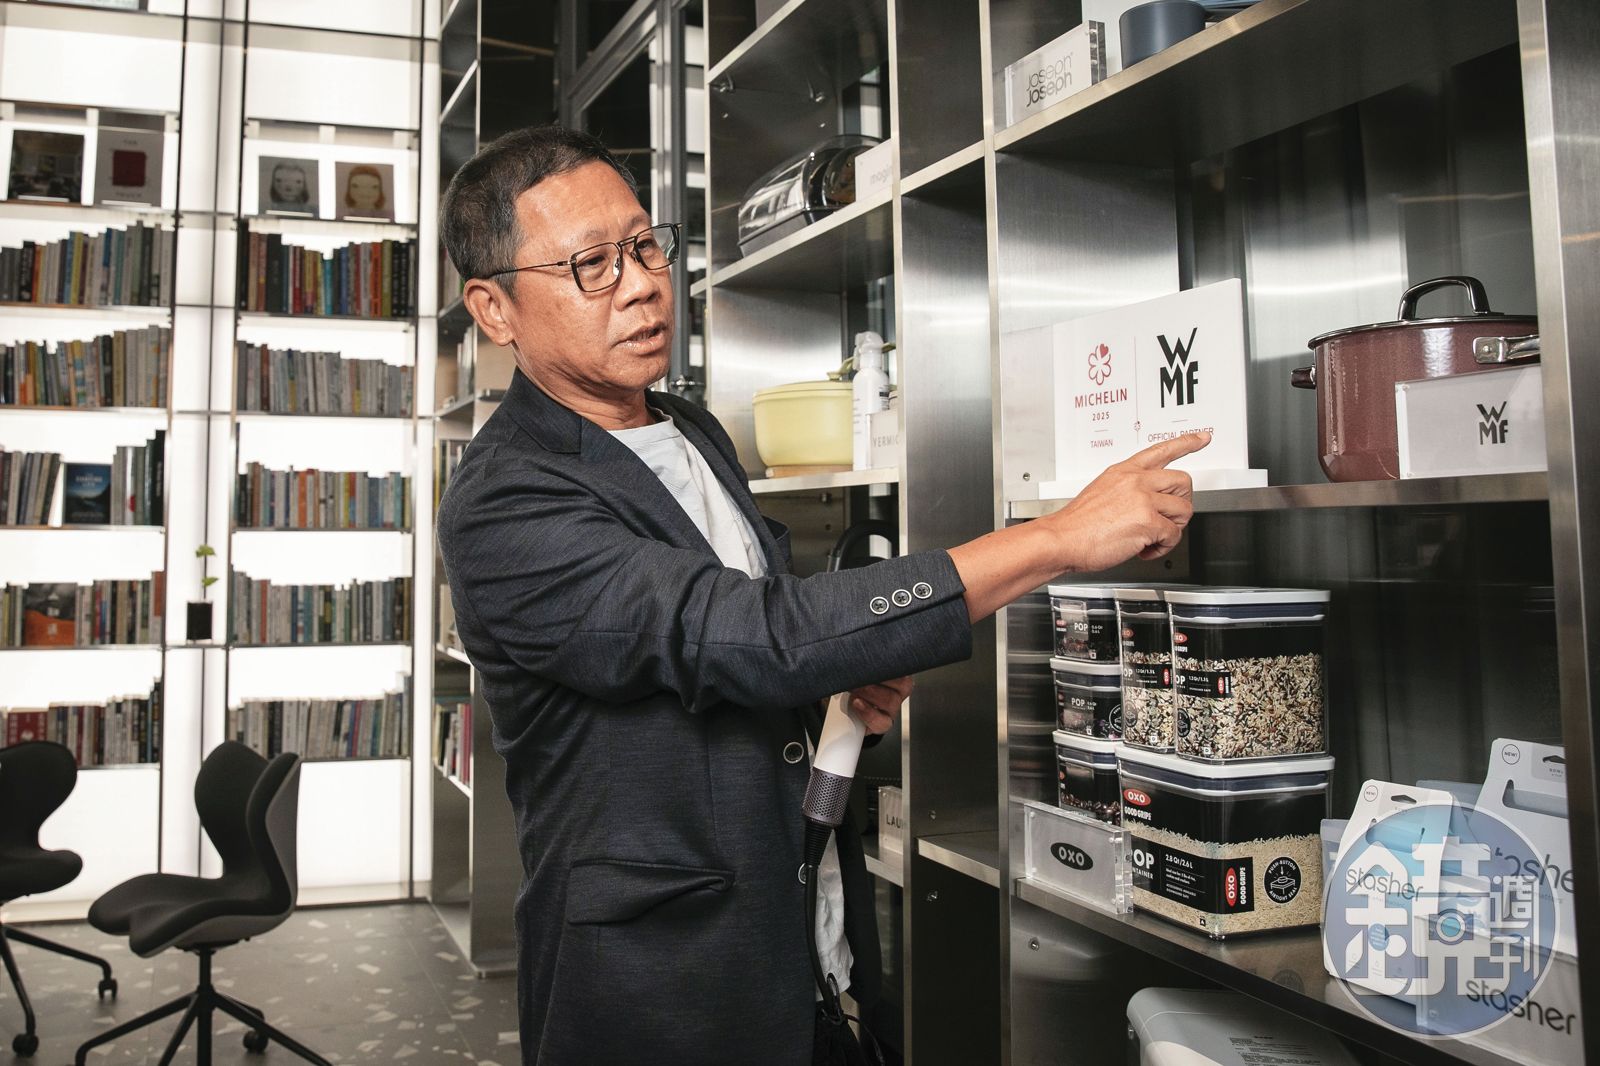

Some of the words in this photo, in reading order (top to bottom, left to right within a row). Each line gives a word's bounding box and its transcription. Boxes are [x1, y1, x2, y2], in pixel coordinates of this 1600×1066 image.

[1156, 327, 1198, 408] WMF
[1074, 388, 1128, 408] MICHELIN
[1092, 411, 1110, 421] 2025
[1476, 401, 1508, 445] WMF
[1090, 439, 1113, 448] TAIWAN
[1074, 622, 1088, 631] POP
[1175, 675, 1186, 685] OP
[1071, 698, 1085, 707] POP
[1127, 791, 1146, 804] OXO
[1058, 846, 1085, 867] OXO
[1132, 848, 1155, 869] OP
[1227, 875, 1236, 899] OXO
[1345, 867, 1424, 902] stasher
[1466, 979, 1576, 1035] stasher
